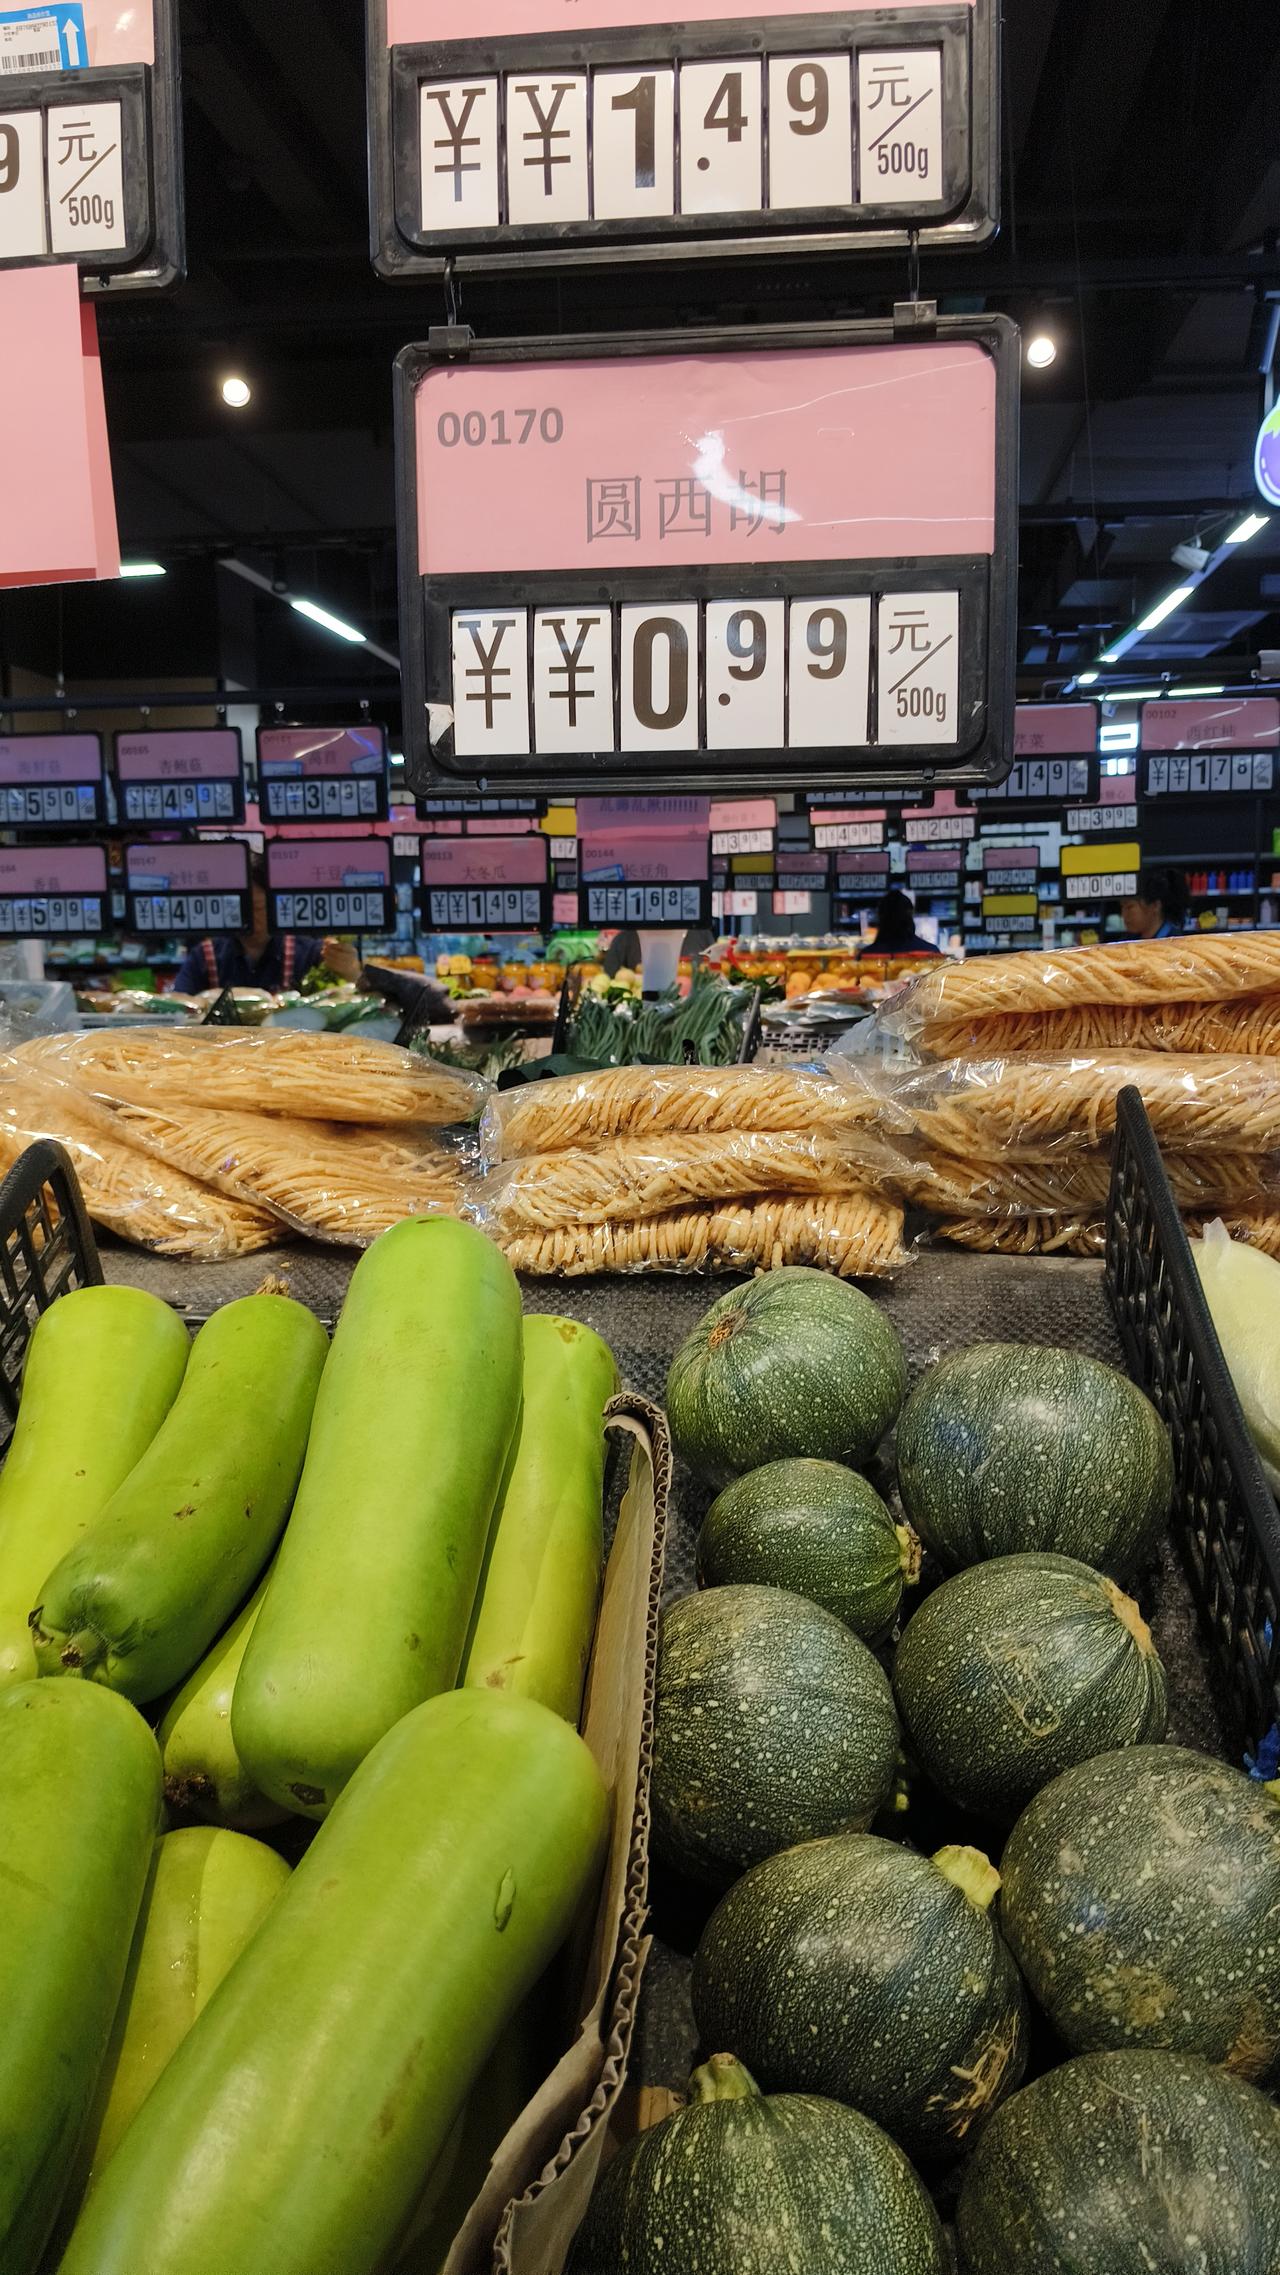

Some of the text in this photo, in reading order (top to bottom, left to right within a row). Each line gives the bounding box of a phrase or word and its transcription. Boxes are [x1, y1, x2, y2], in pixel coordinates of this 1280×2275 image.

[437, 407, 564, 448] 00170
[463, 865, 507, 881] 大冬瓜
